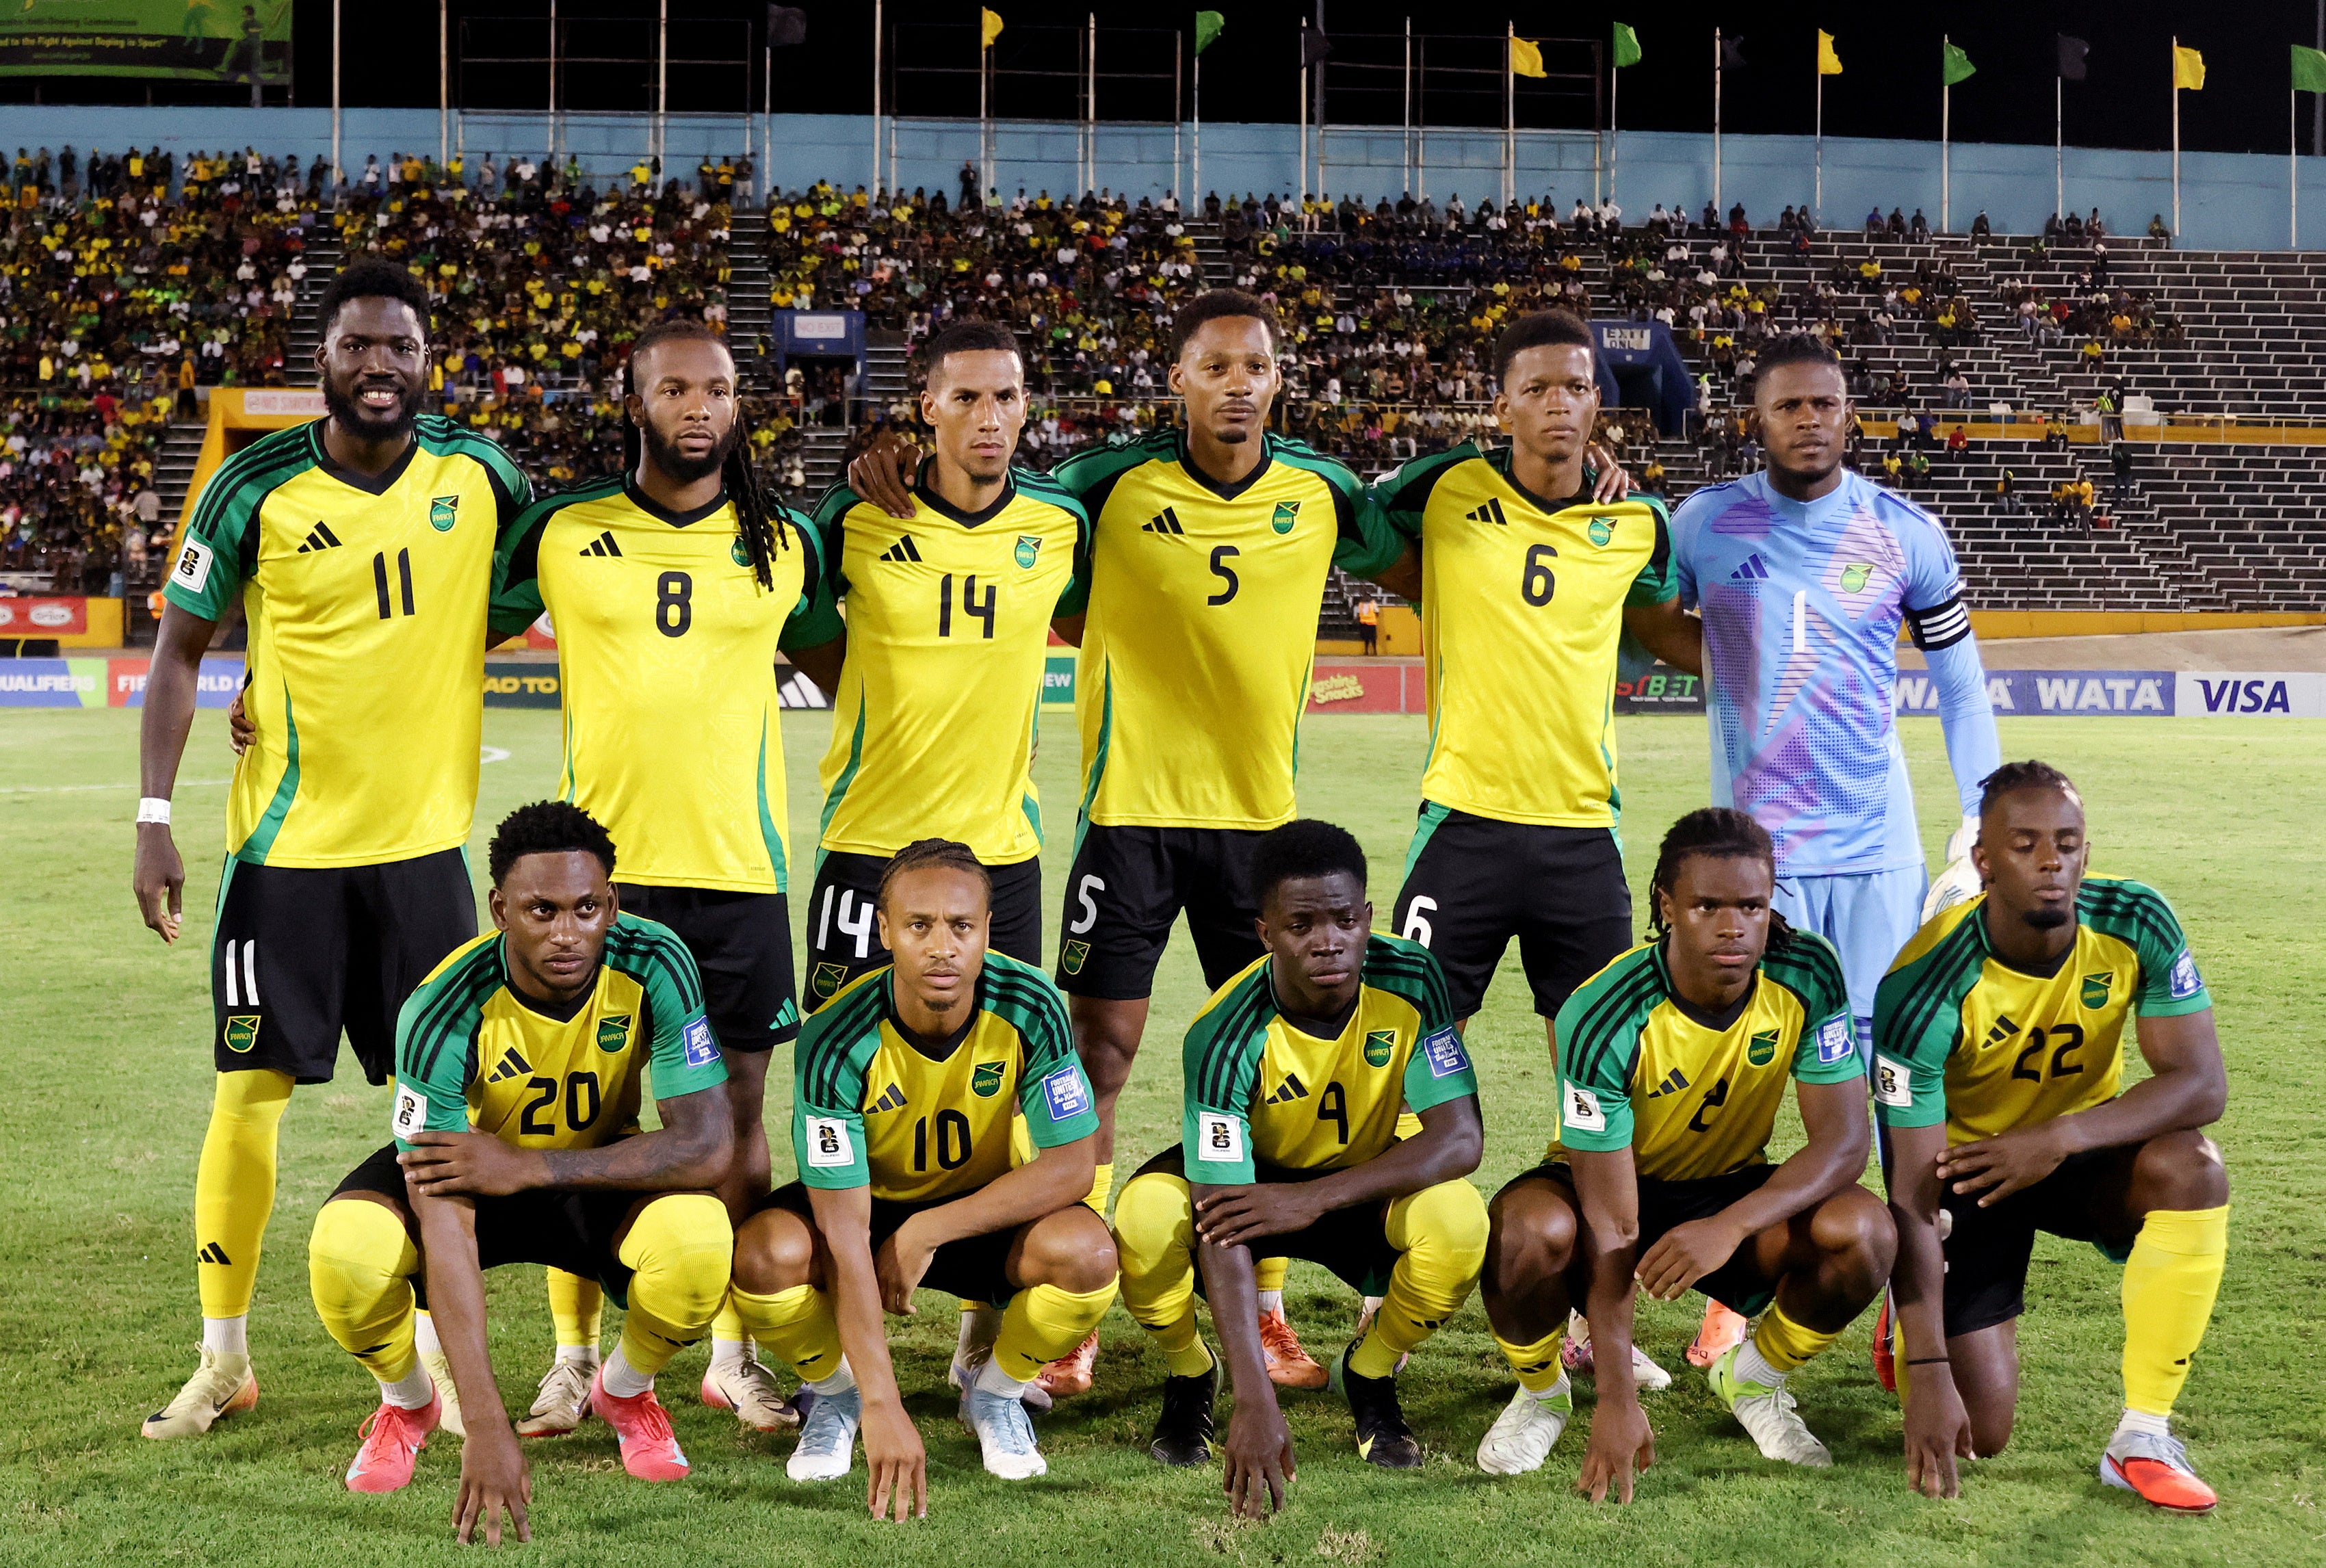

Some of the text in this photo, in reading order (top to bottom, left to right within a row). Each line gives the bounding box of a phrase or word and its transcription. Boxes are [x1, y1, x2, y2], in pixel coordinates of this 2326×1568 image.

[373, 547, 415, 620] 11
[655, 571, 692, 638] 8
[939, 573, 996, 638] 14
[1207, 546, 1240, 606] 5
[1522, 544, 1558, 607] 6
[1792, 590, 1806, 653] 1
[0, 674, 94, 692] UALIFIERS
[117, 675, 147, 692] FIF
[197, 675, 233, 692] RLD
[483, 676, 558, 694] AD TO
[1045, 673, 1072, 687] EW
[1315, 685, 1365, 704] Snacks
[2036, 678, 2165, 710] WATA
[2193, 679, 2290, 713] VISA
[816, 885, 874, 958] 14
[1070, 874, 1105, 935] 5
[1402, 895, 1438, 950] 6
[225, 939, 260, 1006] 11
[600, 1032, 624, 1044] JAMAICA
[2011, 1023, 2085, 1083] 22
[520, 1071, 599, 1136] 20
[974, 1077, 999, 1089] JAMAICA
[1317, 1081, 1349, 1145] 9
[1688, 1077, 1729, 1134] 2
[913, 1108, 972, 1172] 10
